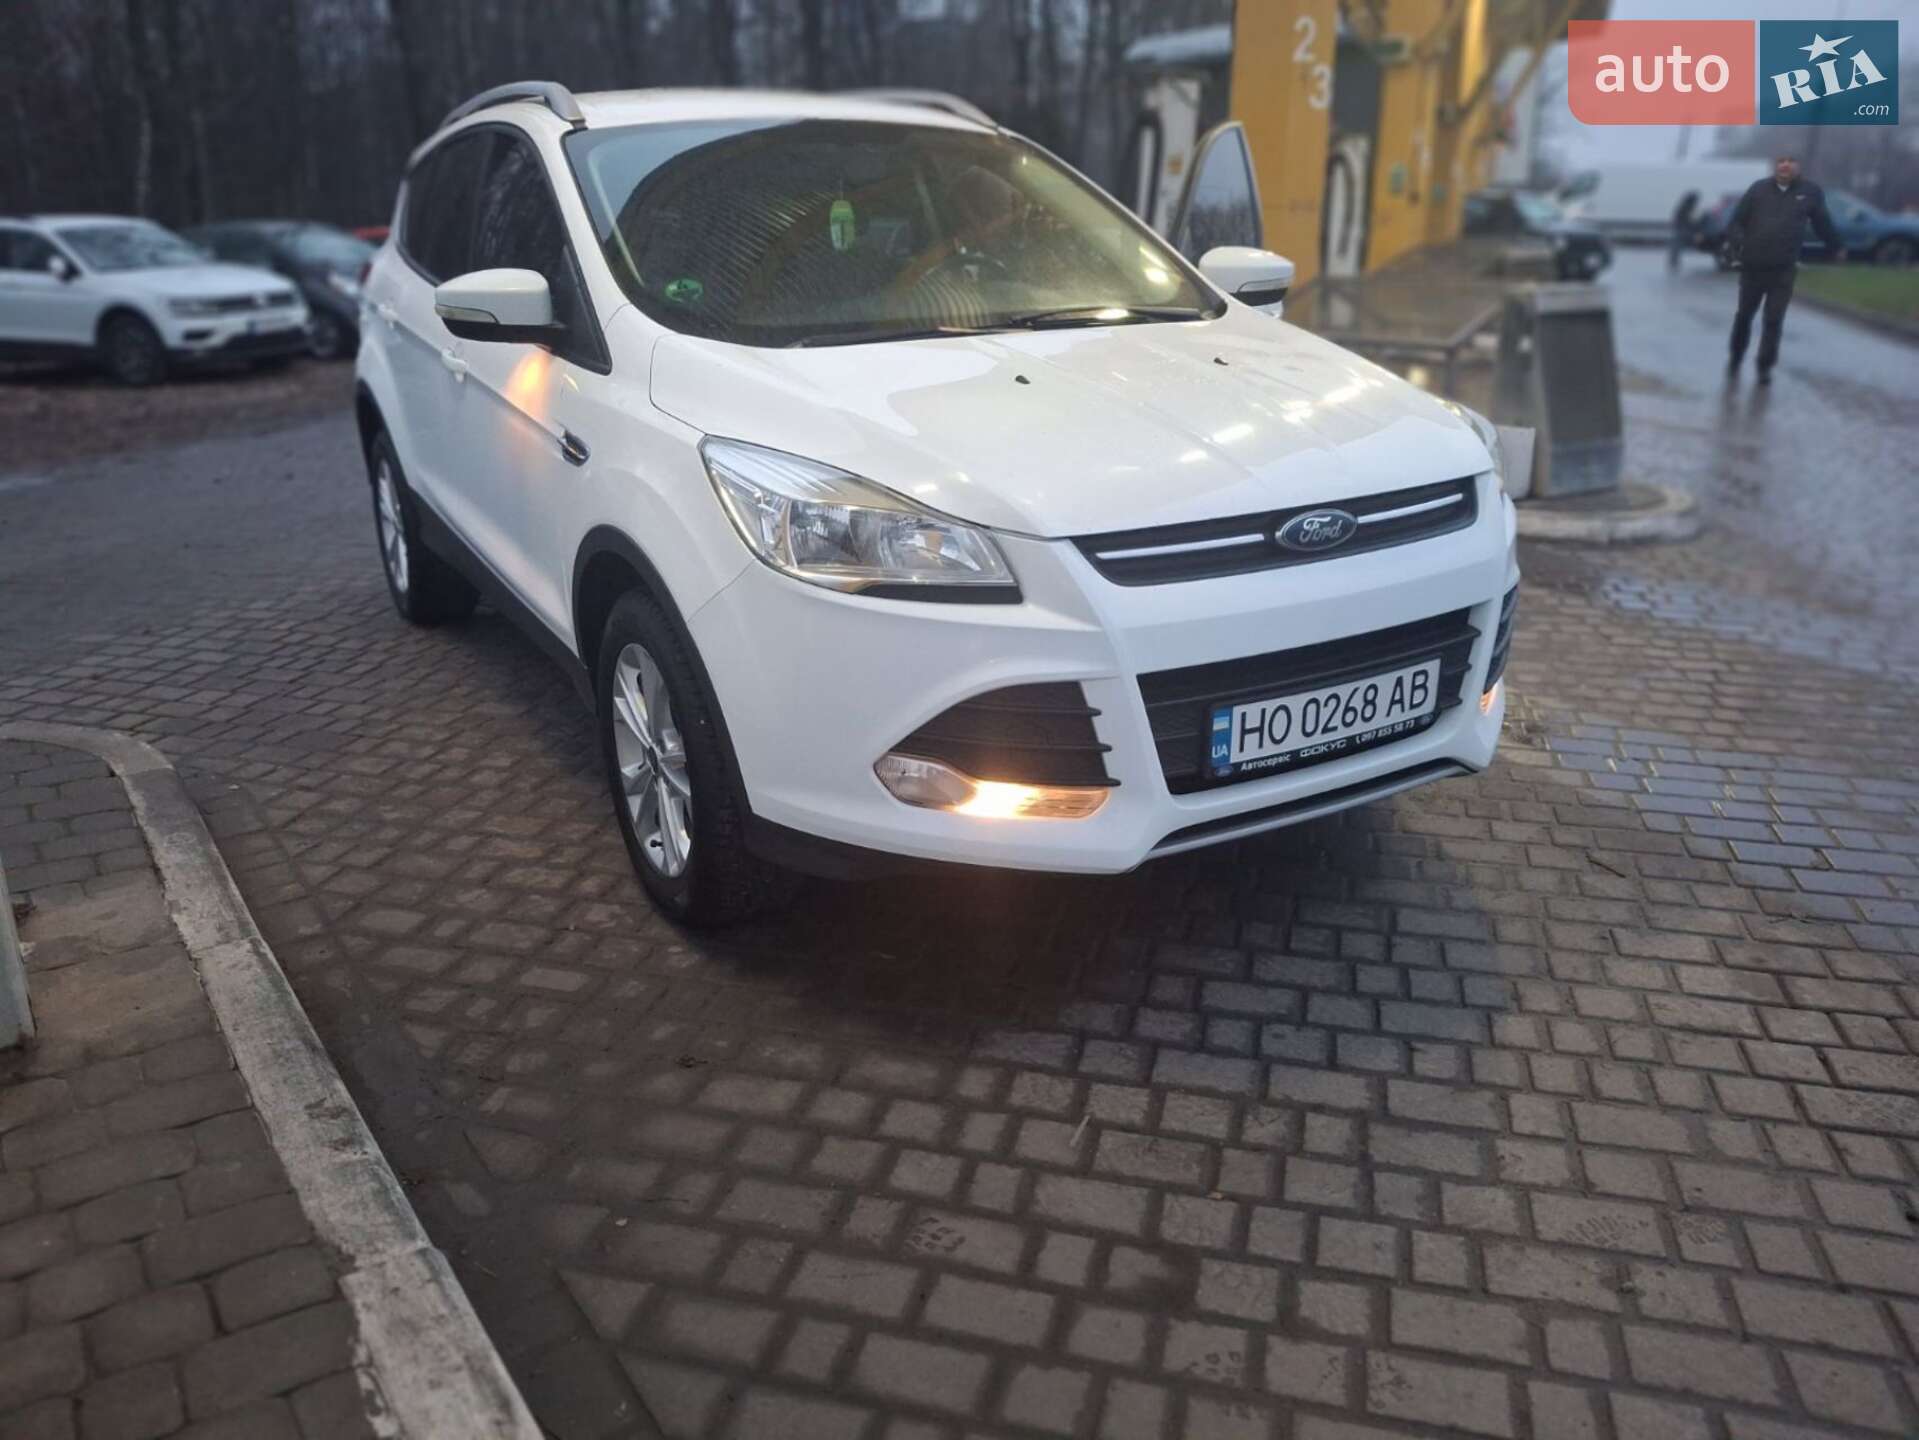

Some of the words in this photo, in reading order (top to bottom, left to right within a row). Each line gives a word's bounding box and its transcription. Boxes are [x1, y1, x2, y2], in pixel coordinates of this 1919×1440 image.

[1292, 16, 1316, 63] 2
[1309, 64, 1332, 108] 3
[1299, 516, 1343, 543] Ford
[1239, 704, 1292, 753] HO
[1301, 683, 1379, 738] 0268
[1386, 669, 1429, 717] AB
[1212, 744, 1229, 759] UA
